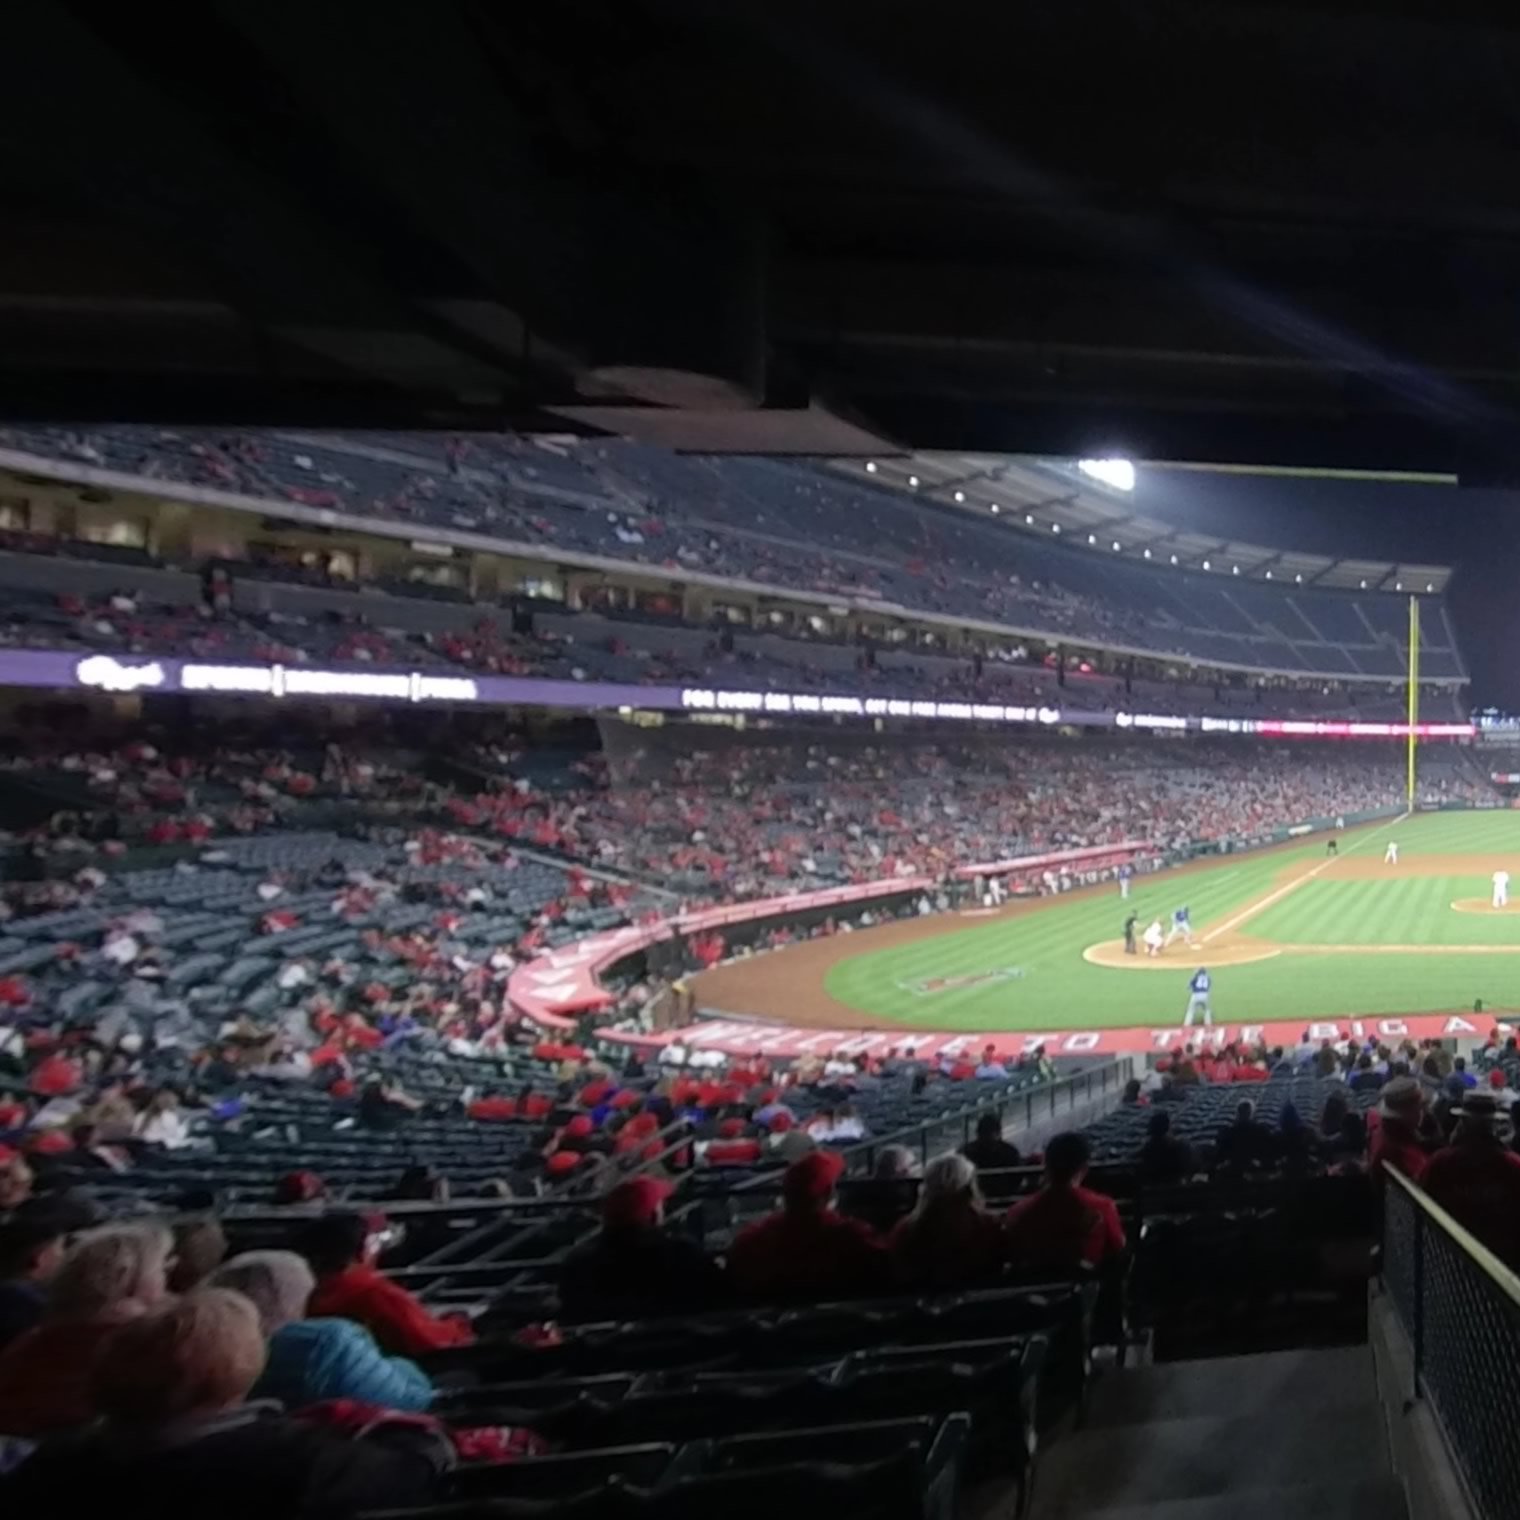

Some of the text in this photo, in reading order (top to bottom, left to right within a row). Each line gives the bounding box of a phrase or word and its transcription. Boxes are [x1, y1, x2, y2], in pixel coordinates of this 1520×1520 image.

[688, 1015, 1477, 1055] WELCOME TO THE BIG A
